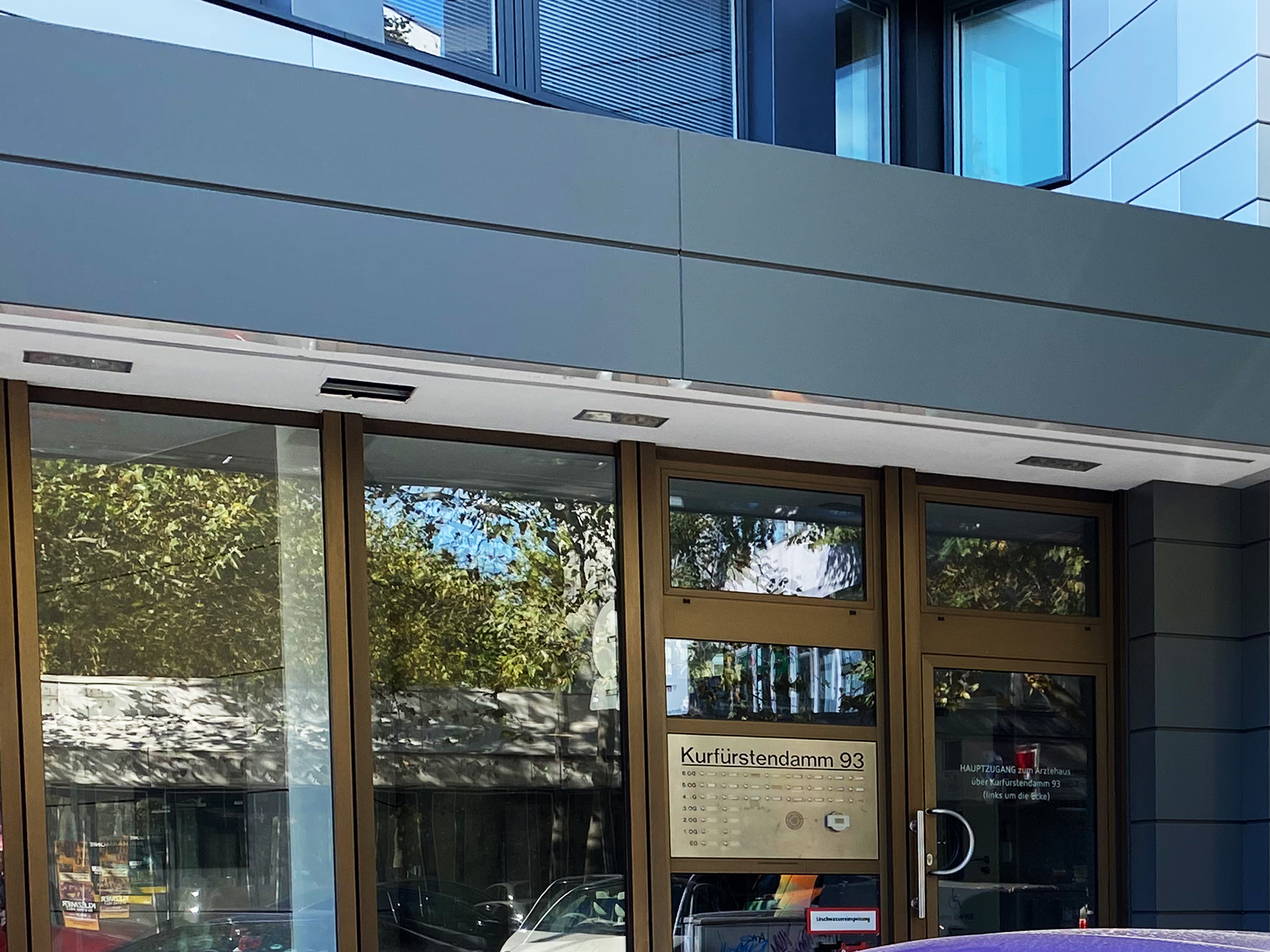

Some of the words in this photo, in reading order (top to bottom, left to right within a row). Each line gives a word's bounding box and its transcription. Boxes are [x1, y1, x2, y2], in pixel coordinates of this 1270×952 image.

[681, 746, 834, 768] Kurfürstendamm
[840, 752, 864, 768] 93
[960, 764, 1016, 774] HAUPTZUGANG
[1051, 780, 1061, 788] 93
